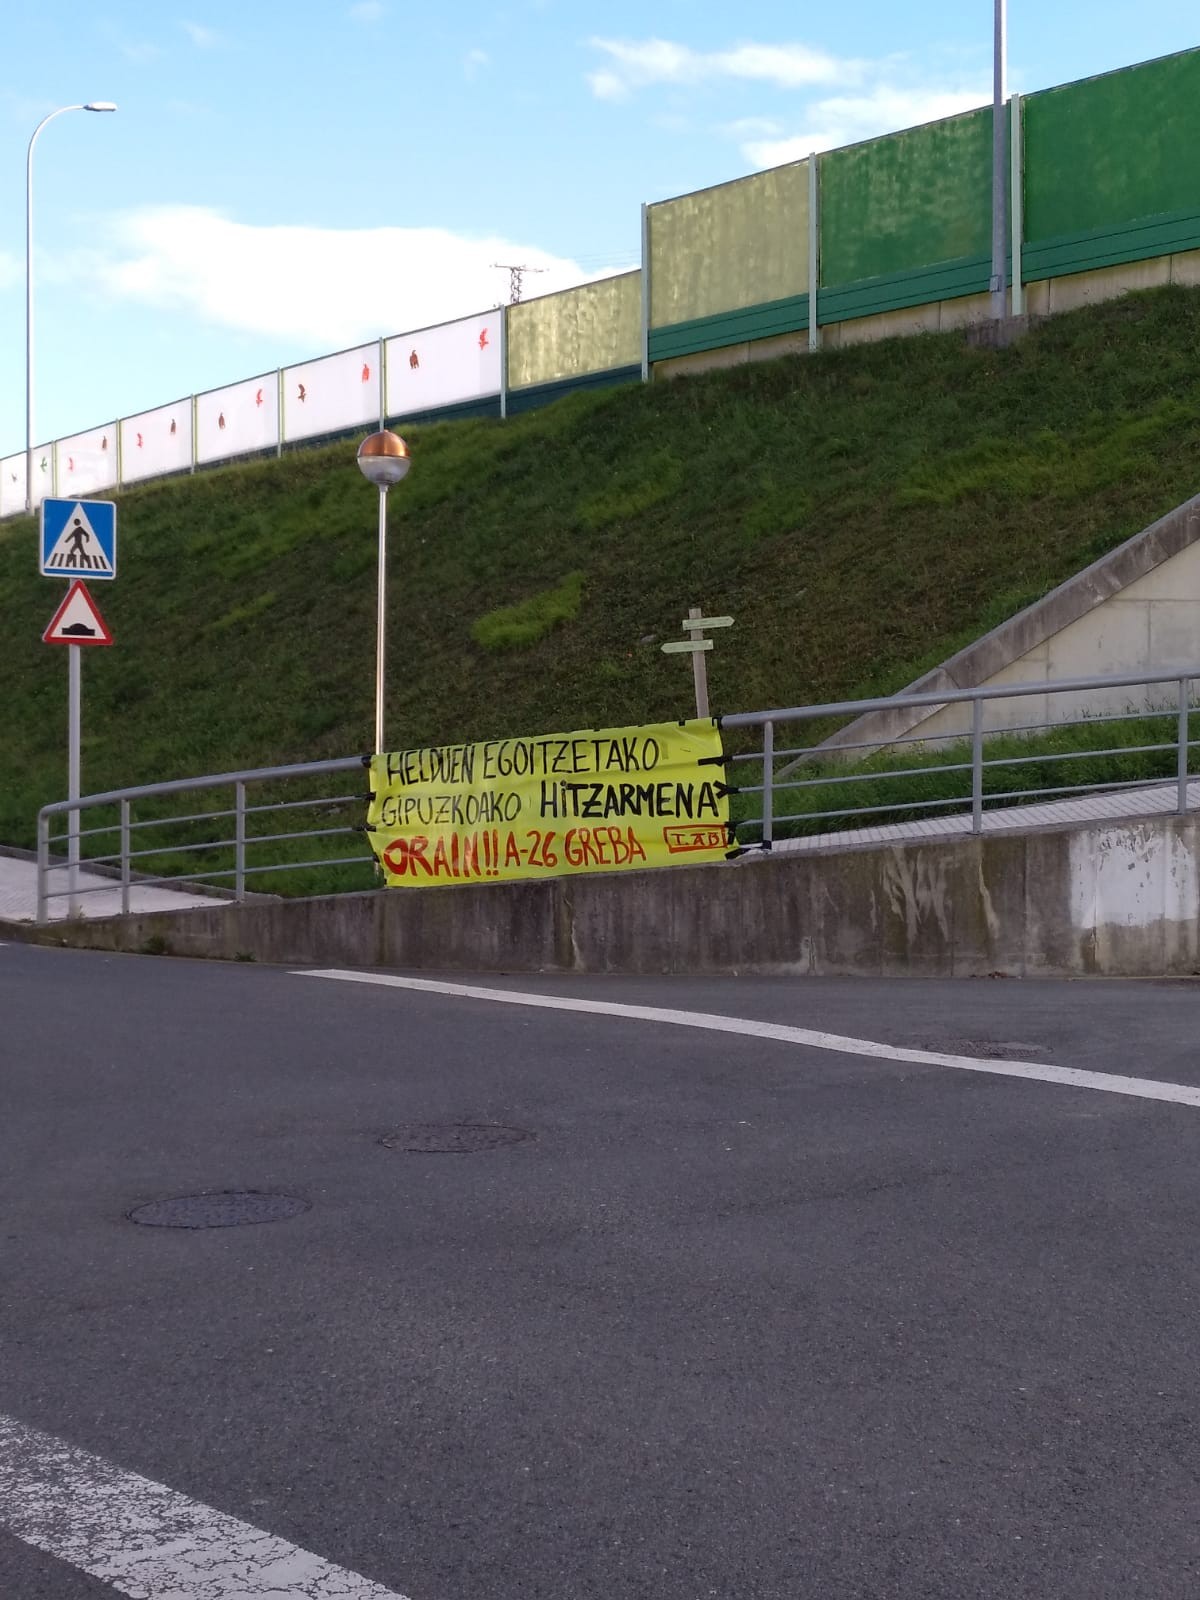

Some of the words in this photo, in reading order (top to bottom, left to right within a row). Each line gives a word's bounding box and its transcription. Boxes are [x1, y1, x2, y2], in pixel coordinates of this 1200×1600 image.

[387, 744, 476, 786] HELDUEN
[483, 738, 660, 779] EGOITZETAKO
[504, 830, 558, 867] A-26
[564, 826, 647, 866] GREBA
